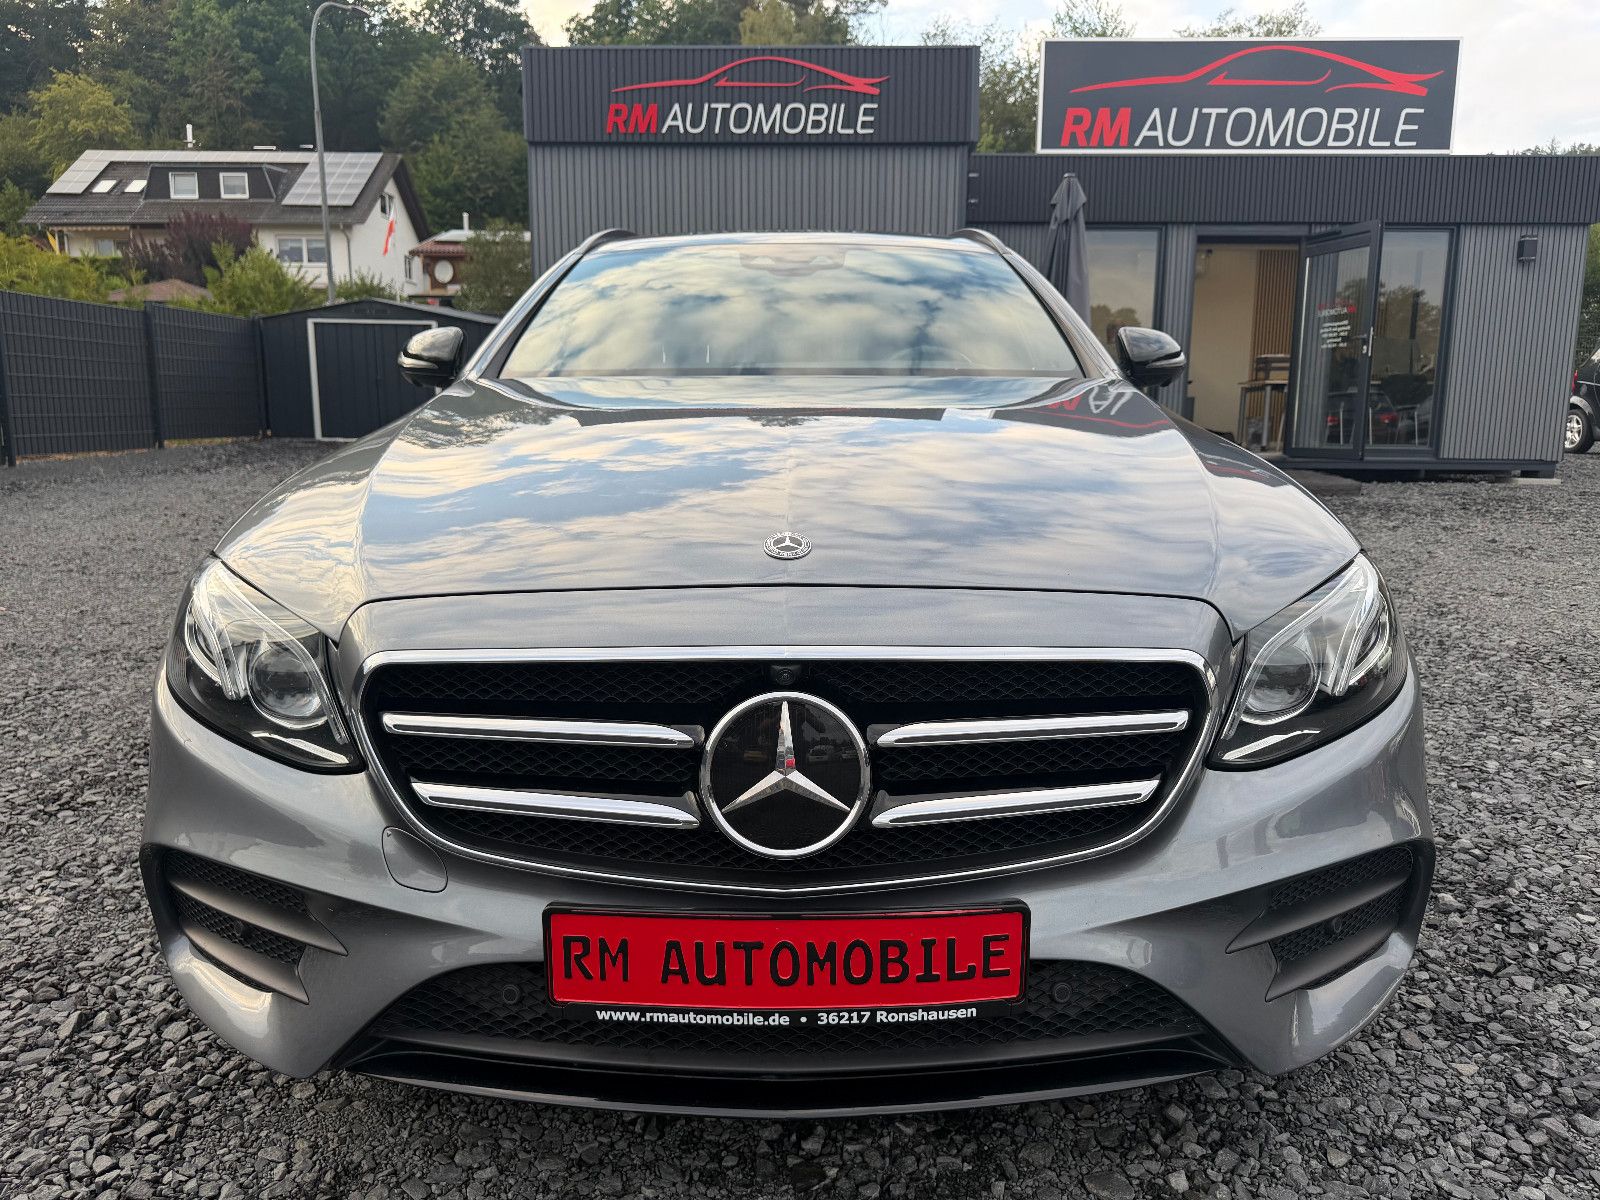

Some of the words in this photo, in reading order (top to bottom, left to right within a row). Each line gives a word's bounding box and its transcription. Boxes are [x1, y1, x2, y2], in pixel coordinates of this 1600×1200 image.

[606, 103, 658, 134] RM
[661, 103, 879, 135] AUTOMOBILE
[1060, 107, 1132, 147] RM
[1134, 107, 1425, 147] AUTOMOBILE
[561, 935, 630, 981] RM
[660, 933, 1012, 986] AUTOMOBILE
[596, 1010, 790, 1026] www.rmautomobile.de
[817, 1011, 871, 1025] 36217
[876, 1007, 977, 1023] Ronshausen
